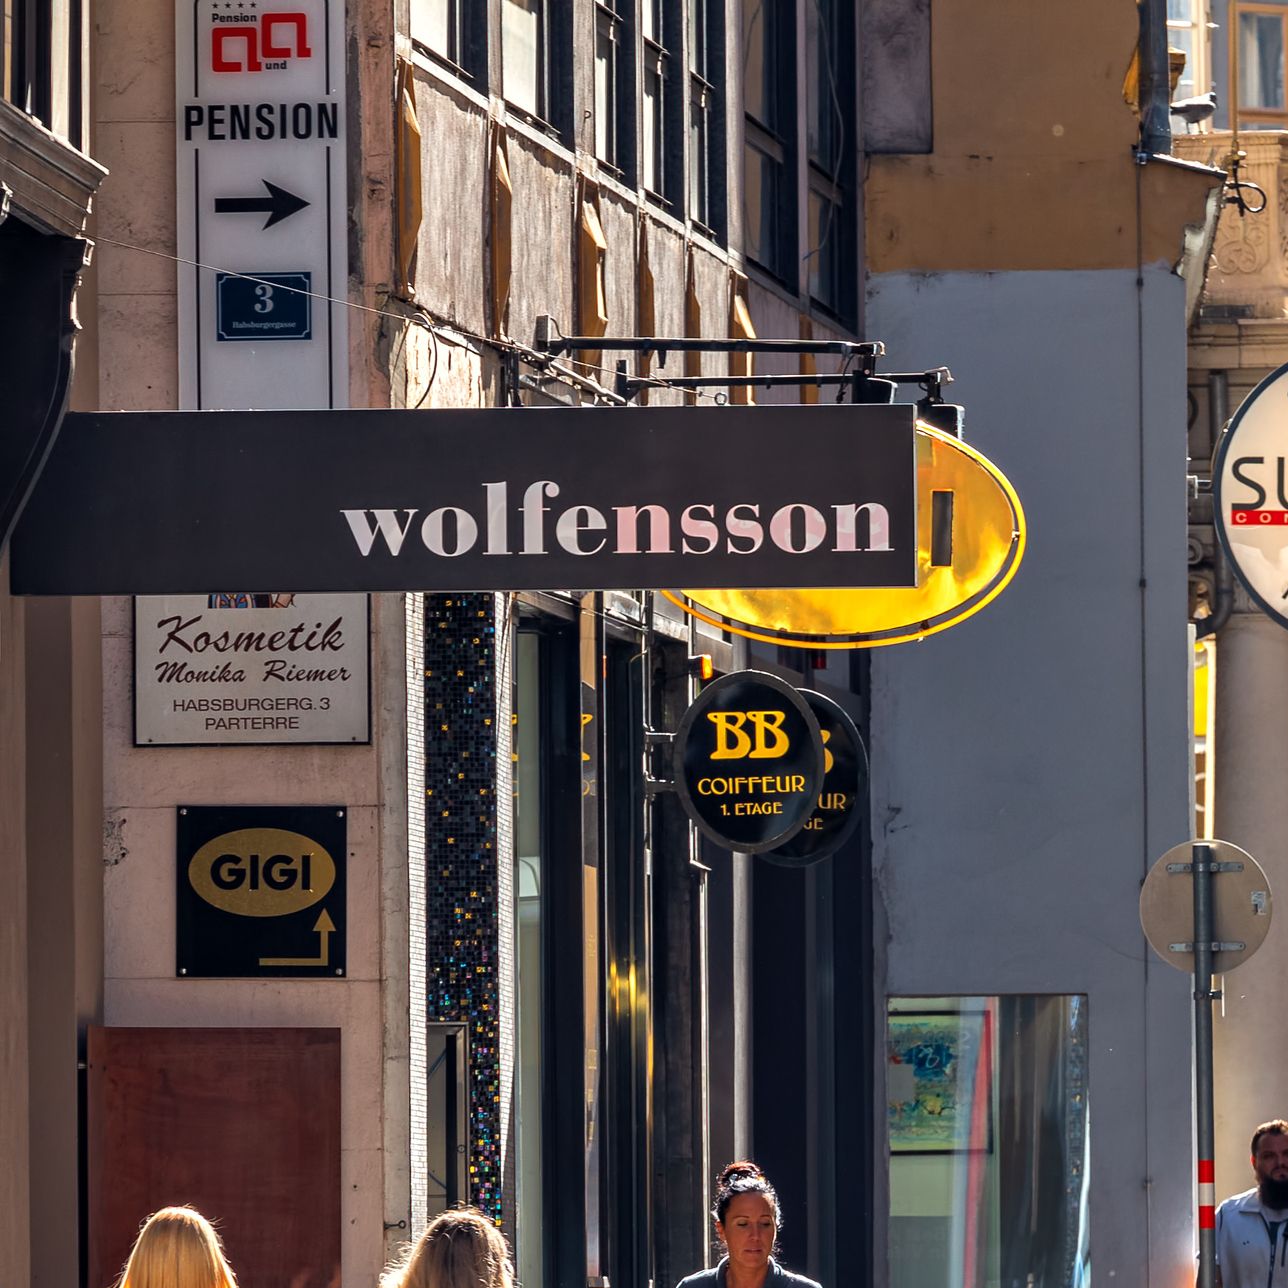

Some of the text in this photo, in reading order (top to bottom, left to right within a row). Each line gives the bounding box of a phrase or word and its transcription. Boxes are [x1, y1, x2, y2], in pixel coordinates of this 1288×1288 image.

[211, 13, 257, 23] Pension
[265, 60, 287, 70] und
[184, 103, 338, 141] PENSION
[253, 284, 274, 313] 3
[340, 480, 895, 558] wolfensson
[157, 614, 345, 653] Kosmetik
[155, 659, 352, 683] Monika Riemer
[173, 697, 331, 712] HABSBURGERG. 3
[205, 716, 300, 730] PARTERRE
[707, 711, 790, 760] BB
[697, 775, 806, 795] COIFFEUR
[734, 802, 783, 816] ETAGE
[210, 854, 314, 891] GIGI
